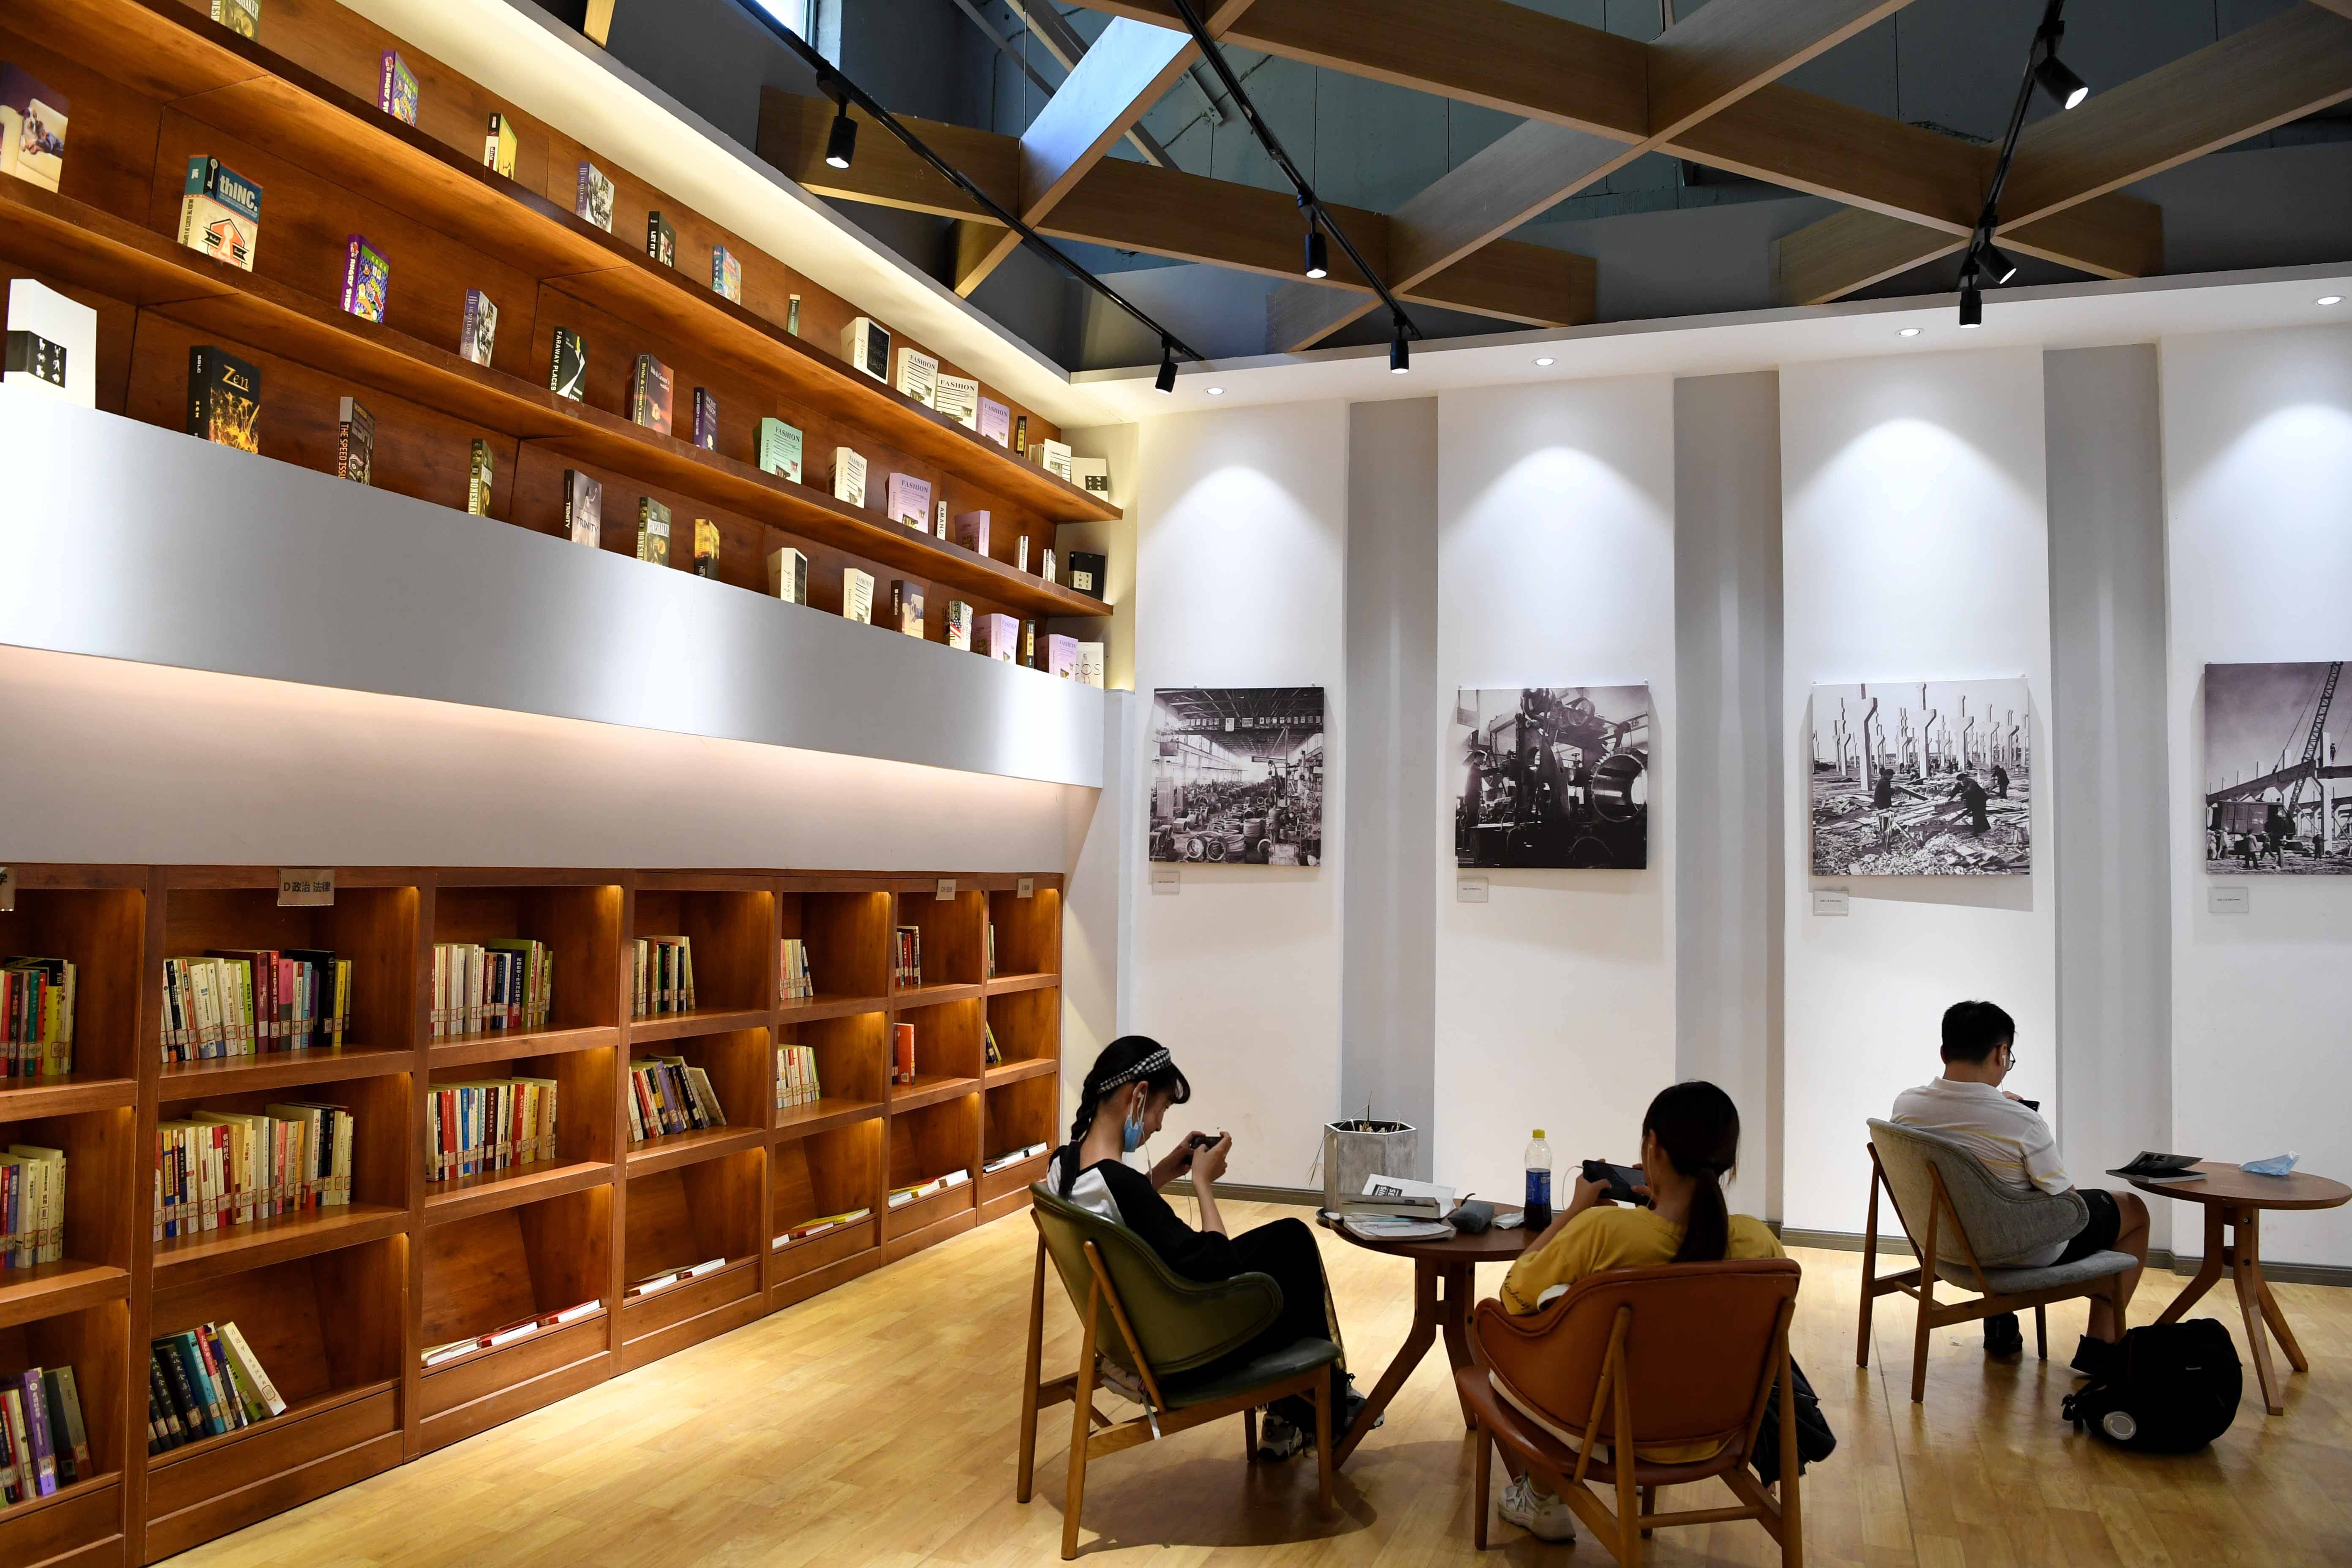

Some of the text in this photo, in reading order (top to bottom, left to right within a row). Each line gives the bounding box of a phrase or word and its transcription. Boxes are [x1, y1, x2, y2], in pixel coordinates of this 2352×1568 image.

[220, 174, 258, 212] thINC.
[347, 258, 356, 286] ANGRY
[550, 331, 562, 391] FARAWAY PLACES
[910, 354, 936, 371] FASHION
[222, 364, 249, 392] Zen
[940, 379, 975, 392] FASHION
[985, 403, 1008, 417] FASHION
[340, 423, 349, 438] THE
[775, 426, 800, 443] FASHION
[339, 439, 348, 461] SPEED
[848, 455, 865, 470] FASHION
[901, 479, 928, 493] FASHION
[576, 516, 598, 534] TRINITY
[855, 575, 872, 589] FASHION
[1059, 639, 1077, 649] FASHION
[284, 881, 331, 893] D 政治 法律
